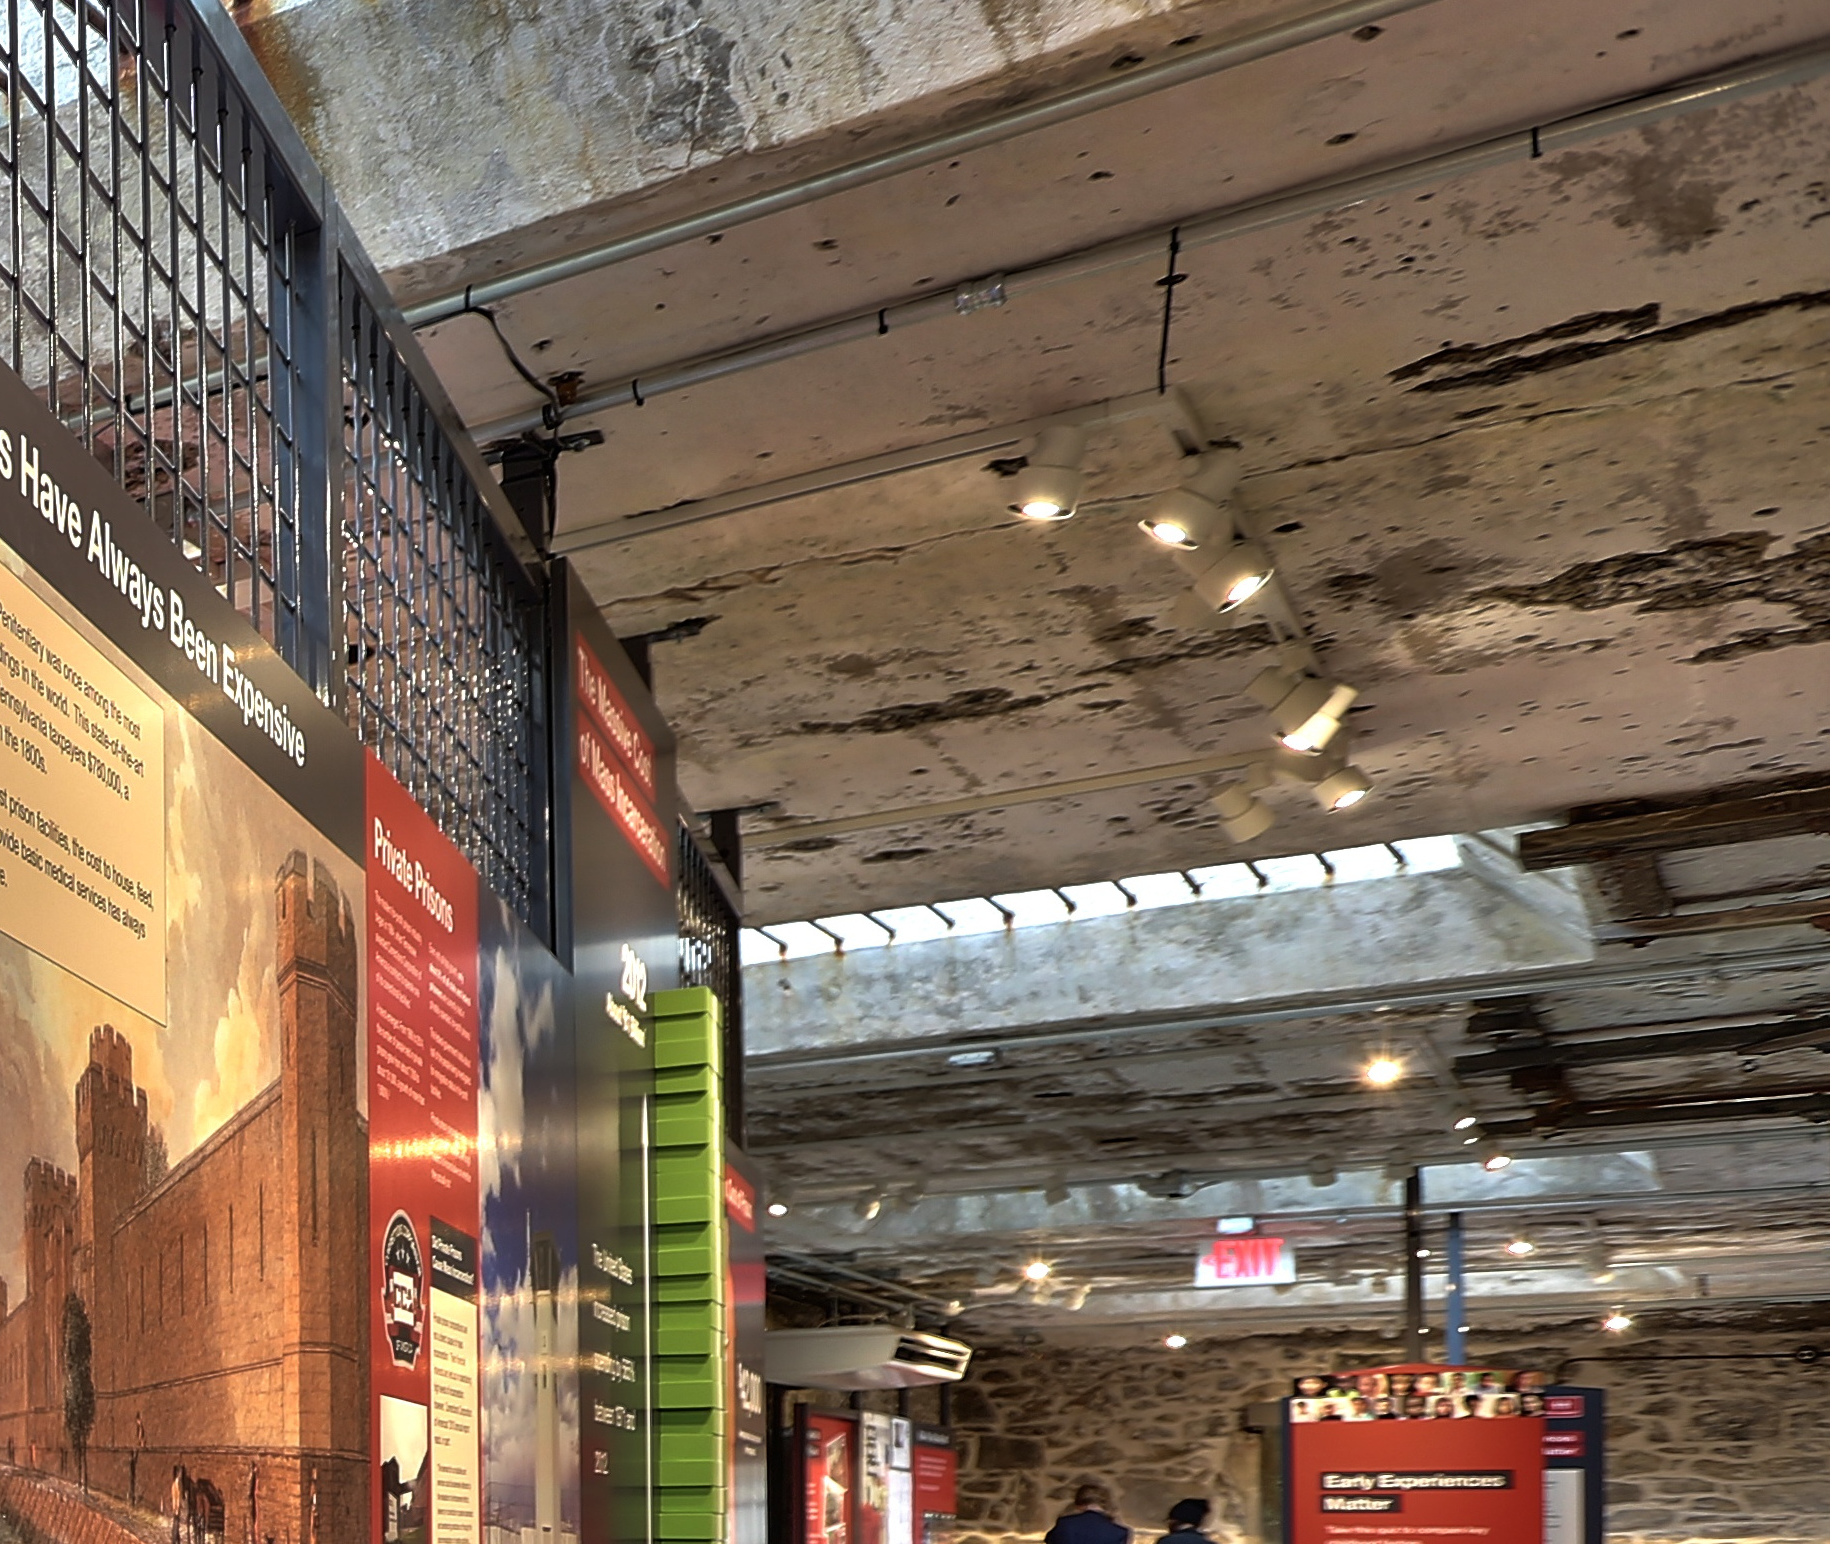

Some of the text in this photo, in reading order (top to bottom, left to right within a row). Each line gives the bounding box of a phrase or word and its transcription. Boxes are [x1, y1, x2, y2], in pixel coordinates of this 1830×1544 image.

[20, 434, 82, 548] Have
[87, 510, 165, 630] Always
[169, 588, 218, 684] Been
[222, 643, 306, 767] Expensive
[22, 660, 30, 685] in
[31, 669, 44, 696] the
[46, 685, 70, 718] world.
[73, 703, 90, 733] This
[91, 722, 144, 778] state-of-the-art
[46, 648, 61, 674] was
[63, 664, 82, 692] once
[84, 681, 108, 719] among
[110, 700, 121, 724] the
[123, 715, 141, 741] most
[578, 646, 652, 788] The Massive Cost
[4, 726, 19, 753] the
[20, 737, 47, 775] 1800s.
[49, 722, 86, 767] taxpayers
[123, 785, 130, 801] a
[580, 732, 666, 873] of Mass Incarceration
[9, 797, 36, 828] prison
[37, 811, 71, 855] facilities,
[72, 837, 85, 862] the
[86, 851, 102, 874] cost
[103, 859, 112, 880] to
[112, 864, 136, 900] house,
[137, 881, 154, 912] feed,
[21, 838, 43, 871] basic
[45, 859, 75, 892] medical
[76, 880, 107, 913] services
[108, 896, 121, 922] has
[122, 909, 146, 940] always
[374, 817, 413, 893] Private
[415, 861, 454, 933] Prisons
[621, 943, 647, 1012] 2012
[1213, 1237, 1284, 1278] EXIT
[1323, 1473, 1508, 1491] Early Experiences
[1323, 1497, 1394, 1512] Matter
